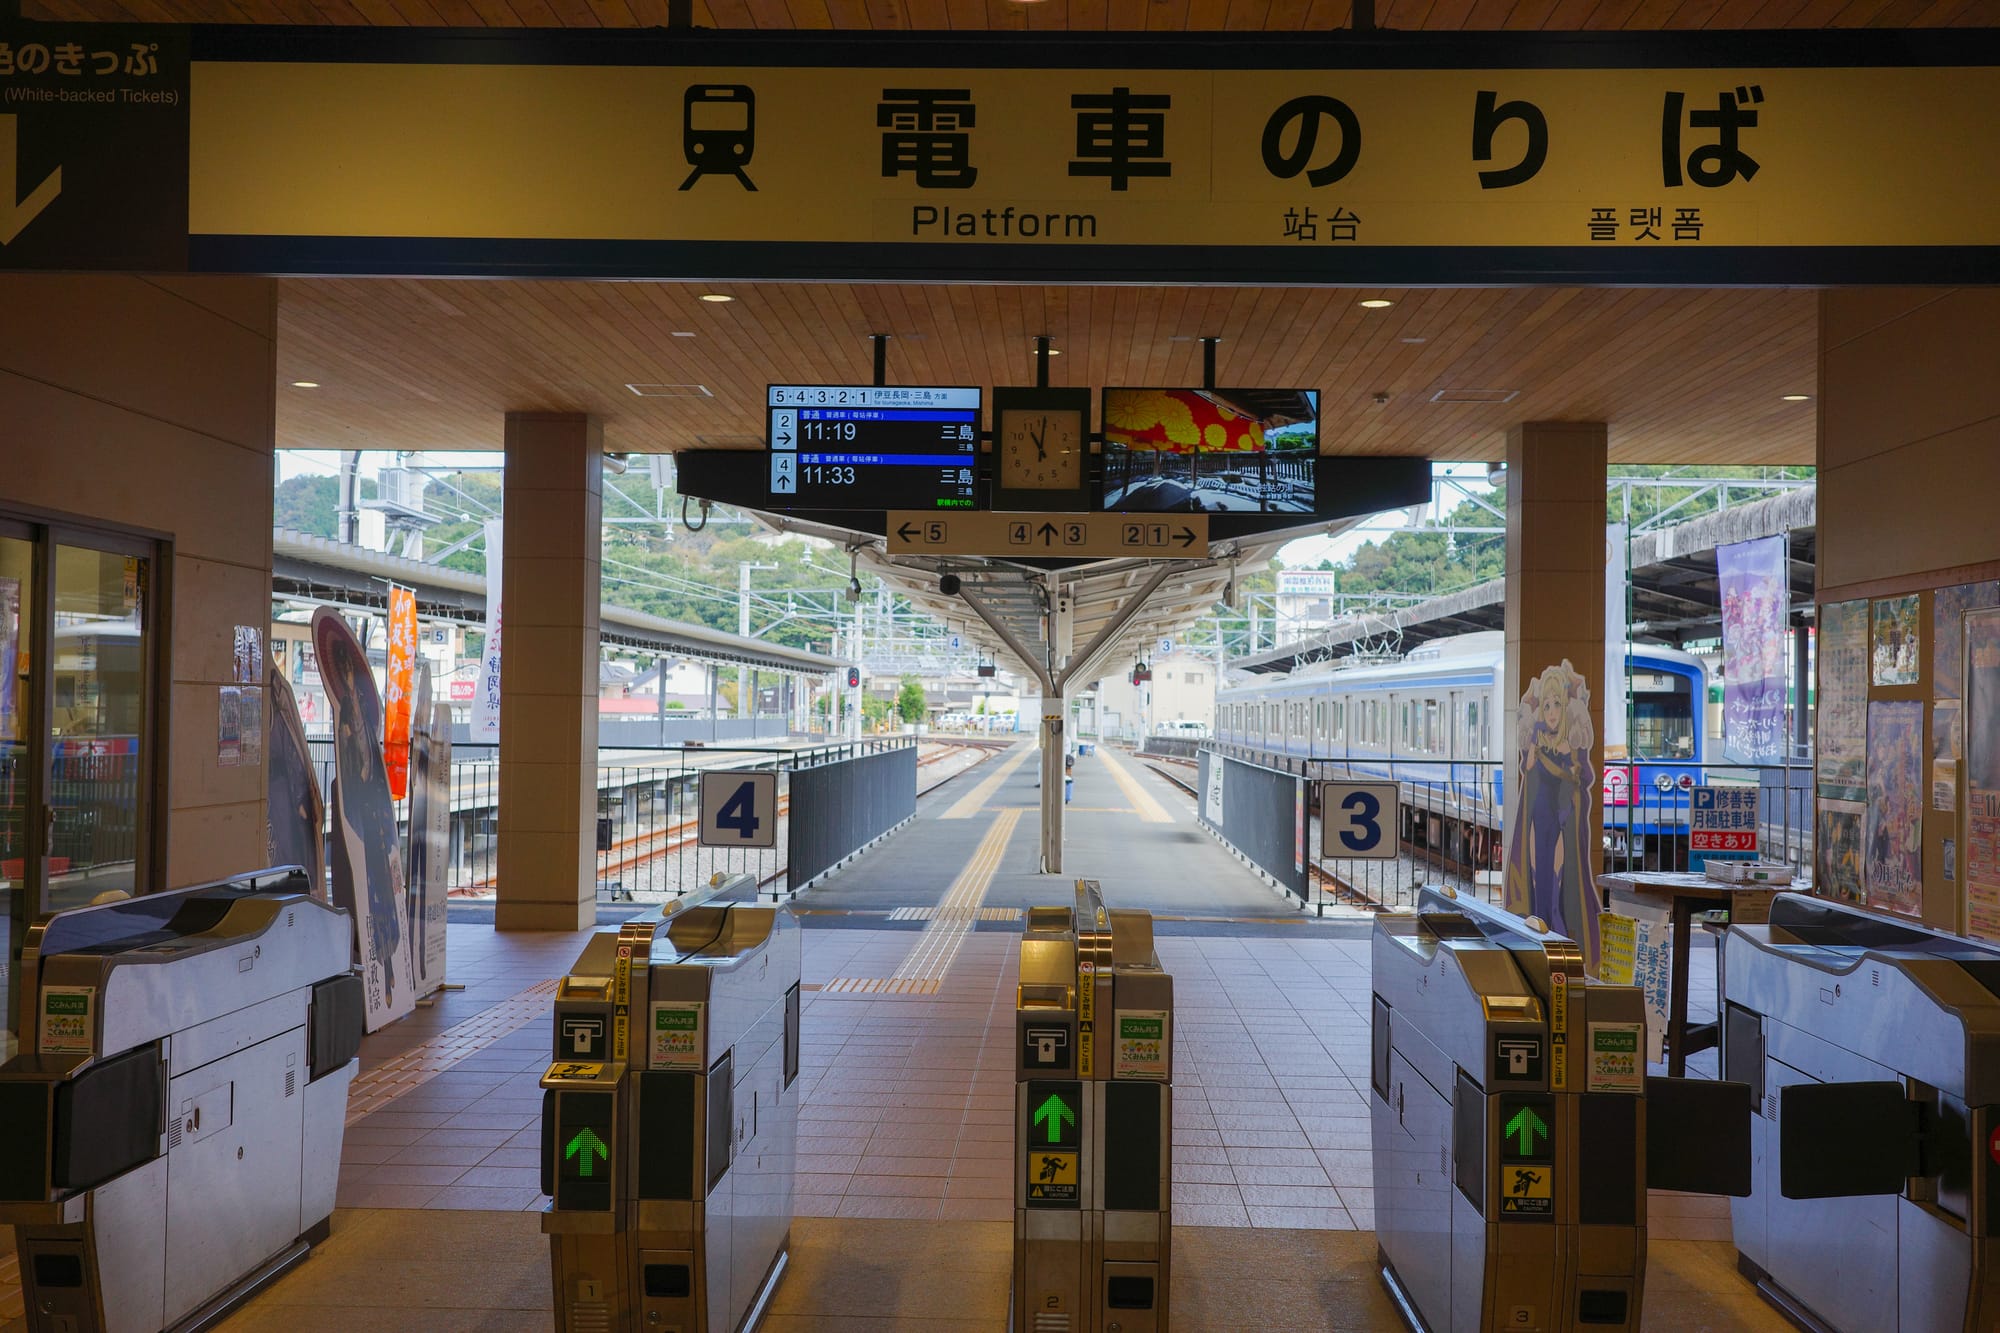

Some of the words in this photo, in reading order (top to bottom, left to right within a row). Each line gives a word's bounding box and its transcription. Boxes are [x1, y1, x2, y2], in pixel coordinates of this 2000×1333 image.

[4, 87, 115, 104] (White-backed
[120, 88, 179, 106] Tickets)
[877, 85, 1765, 191] 電車のりば
[913, 206, 1096, 237] Platform
[1283, 206, 1362, 241] 站台
[1587, 206, 1704, 241] 플랫폼
[781, 416, 788, 427] 2
[804, 423, 856, 440] 11:19
[941, 425, 974, 440] 三島
[780, 460, 788, 471] 4
[804, 467, 855, 484] 11:33
[940, 468, 973, 484] 三島
[929, 524, 942, 541] 5
[1014, 525, 1026, 542] 4
[1068, 526, 1081, 543] 3
[1127, 526, 1140, 543] 2
[1152, 526, 1162, 543] 1
[436, 631, 443, 641] 5
[952, 637, 958, 648] 4
[1163, 640, 1170, 651] 3
[1716, 790, 1756, 809] 修善寺
[716, 781, 759, 838] 4
[1339, 791, 1381, 851] 3
[1693, 810, 1755, 830] 月極駐車場
[1694, 833, 1753, 849] 空きあり
[588, 1285, 594, 1297] 1
[1047, 1296, 1059, 1308] 2
[1516, 1310, 1529, 1323] 3
